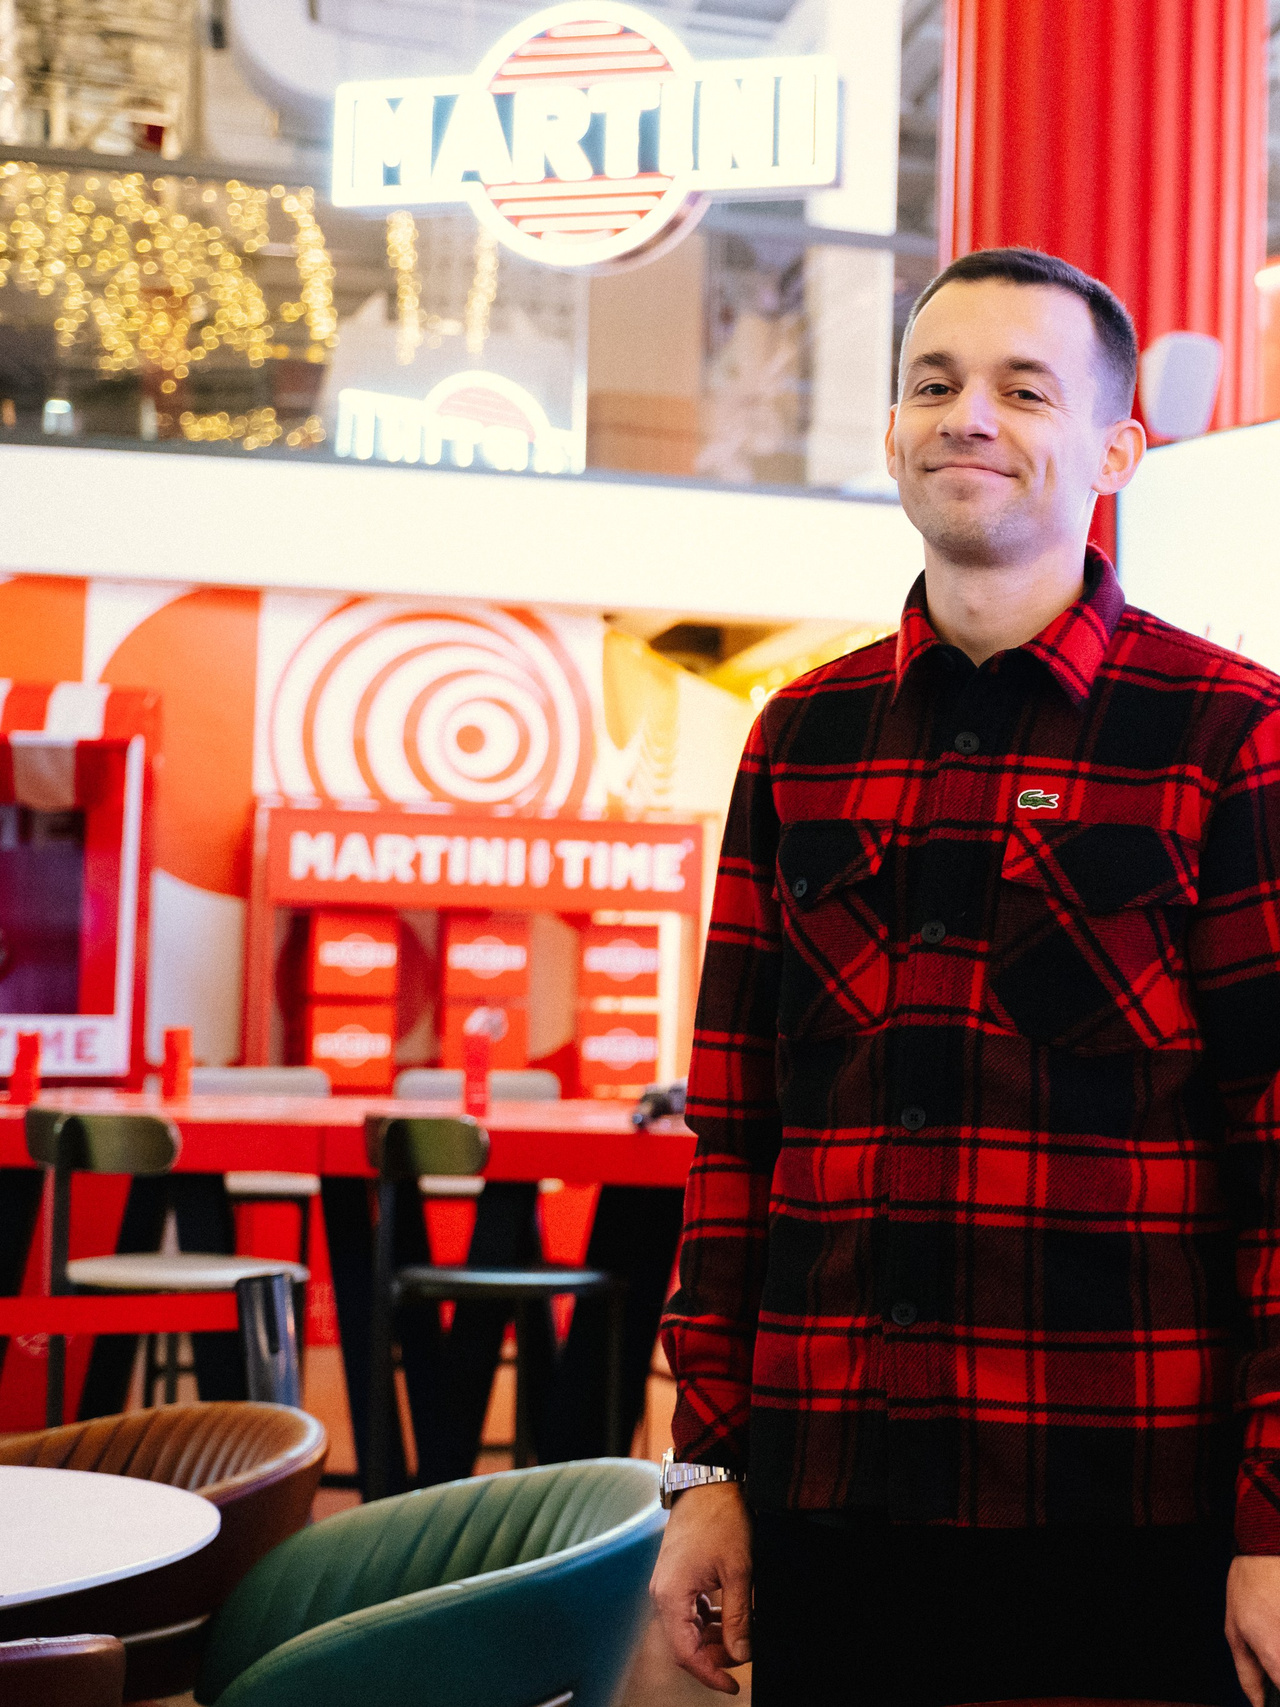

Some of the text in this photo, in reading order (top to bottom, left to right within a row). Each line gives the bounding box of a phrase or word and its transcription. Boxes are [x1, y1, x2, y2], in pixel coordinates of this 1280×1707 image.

[352, 75, 815, 188] MARTINI
[289, 830, 686, 892] MARTINI TIME
